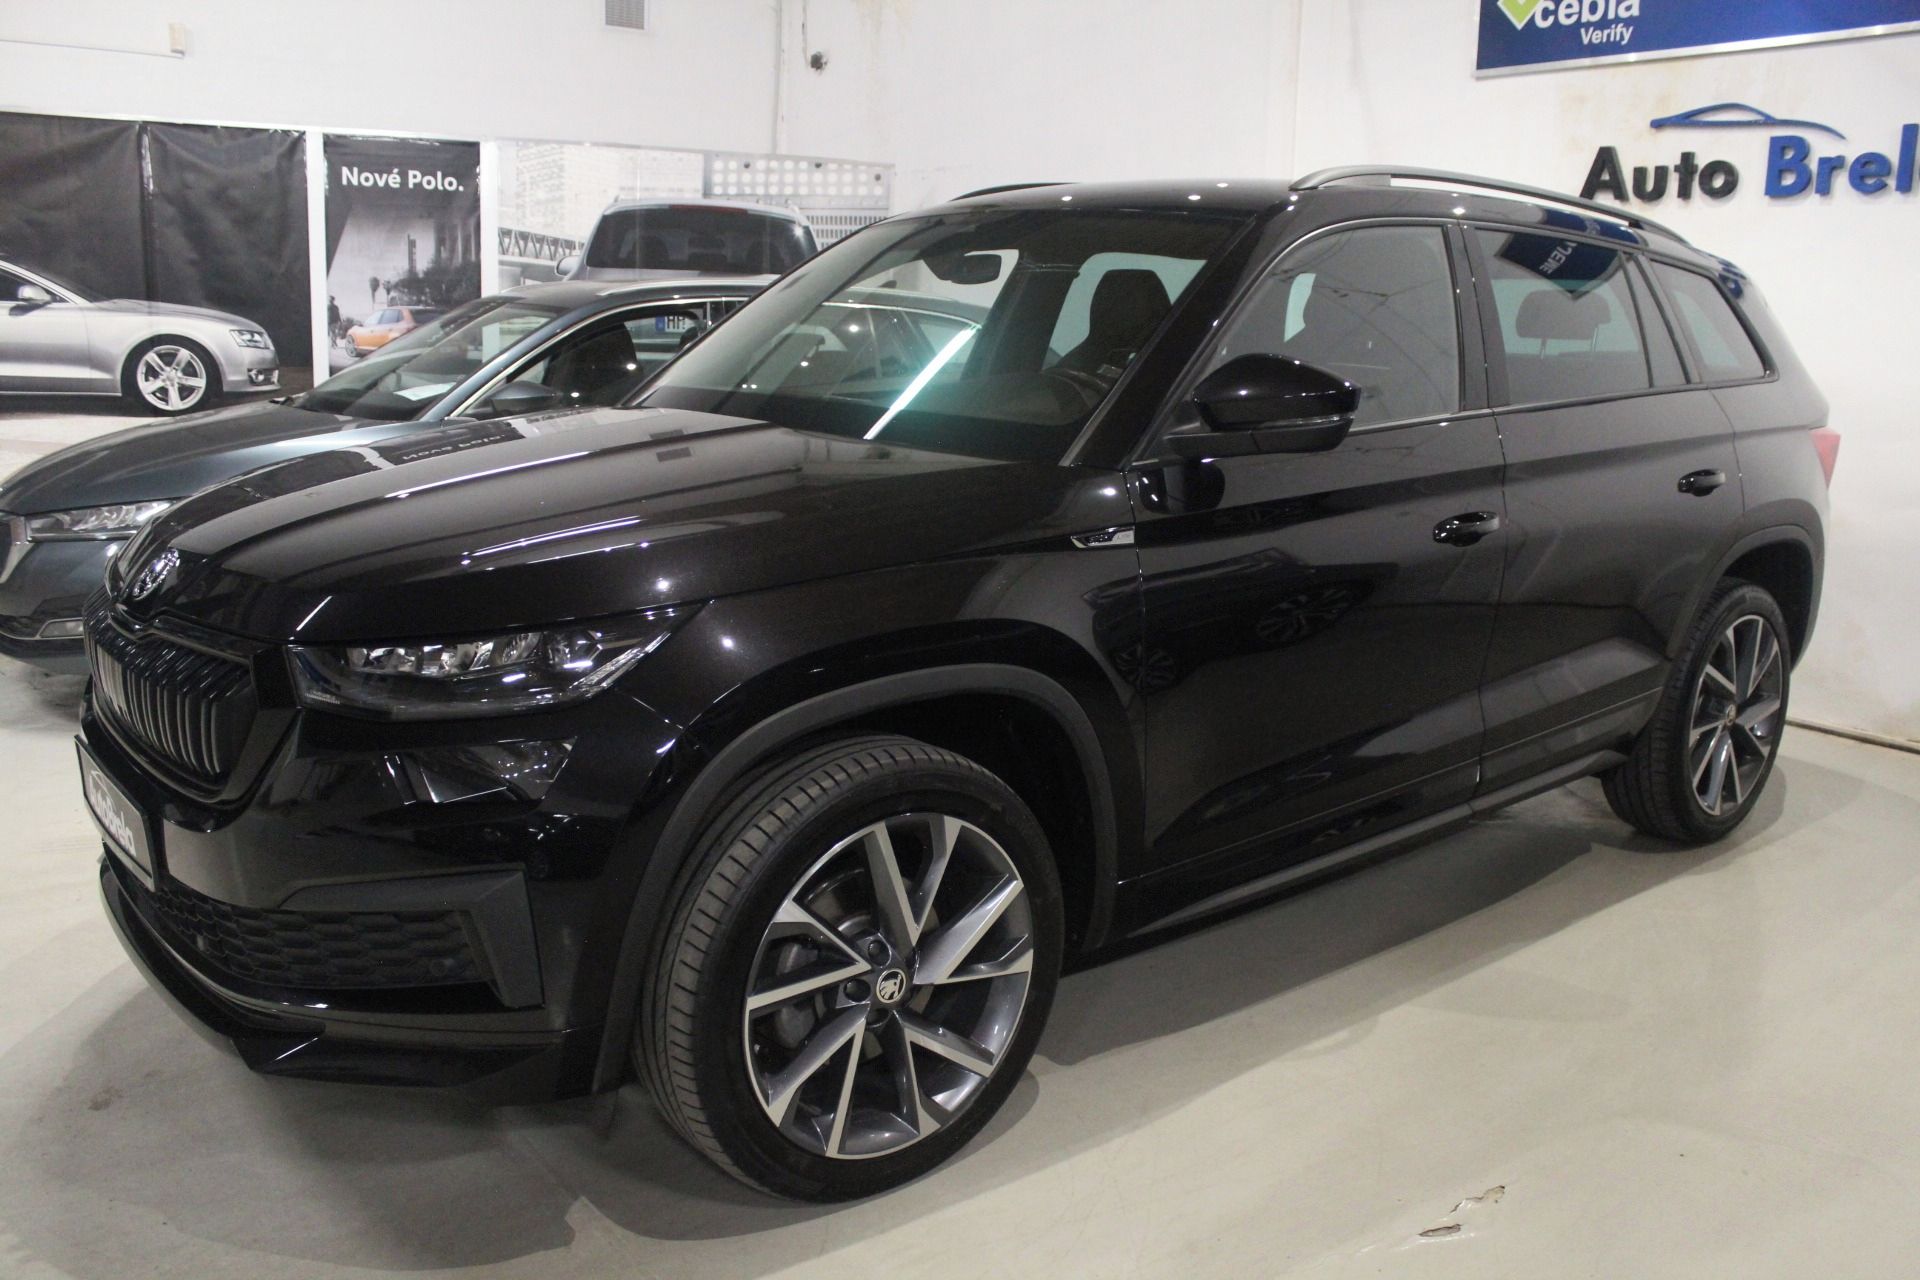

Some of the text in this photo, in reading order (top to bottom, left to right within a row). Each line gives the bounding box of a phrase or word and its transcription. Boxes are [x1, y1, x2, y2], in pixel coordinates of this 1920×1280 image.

[1580, 23, 1633, 45] Verify
[1579, 123, 1920, 202] Auto Brel
[341, 166, 465, 192] Nové Polo.
